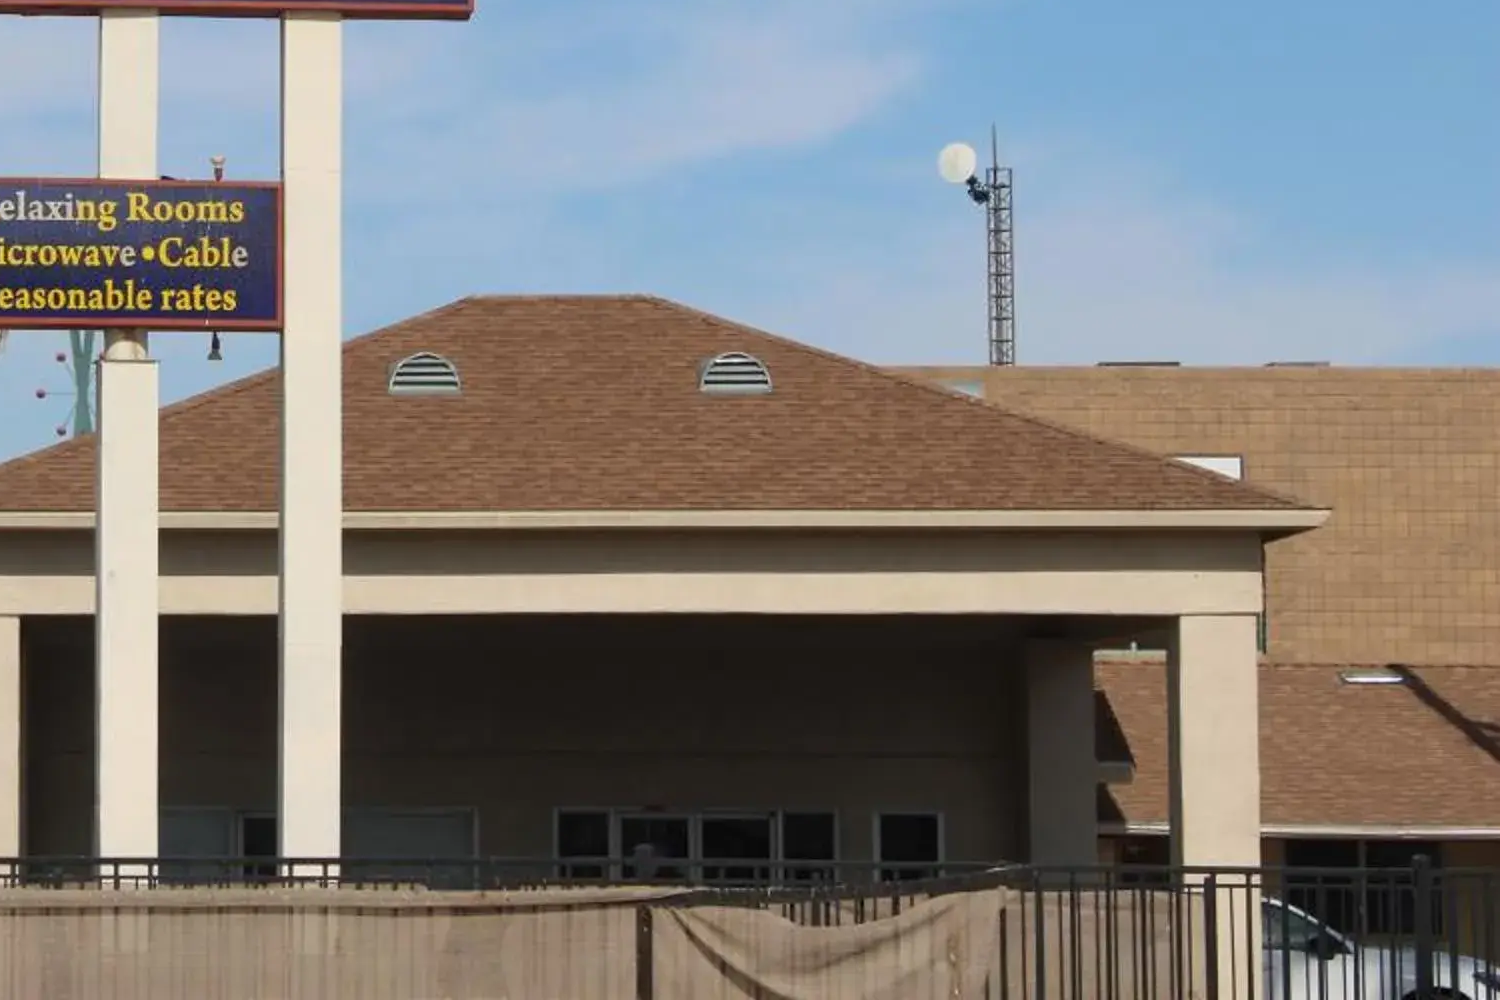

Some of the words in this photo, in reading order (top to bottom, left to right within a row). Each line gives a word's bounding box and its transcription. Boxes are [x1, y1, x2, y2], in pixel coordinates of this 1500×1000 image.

[126, 192, 245, 223] Rooms
[158, 237, 249, 268] Cable
[161, 285, 238, 312] rates
